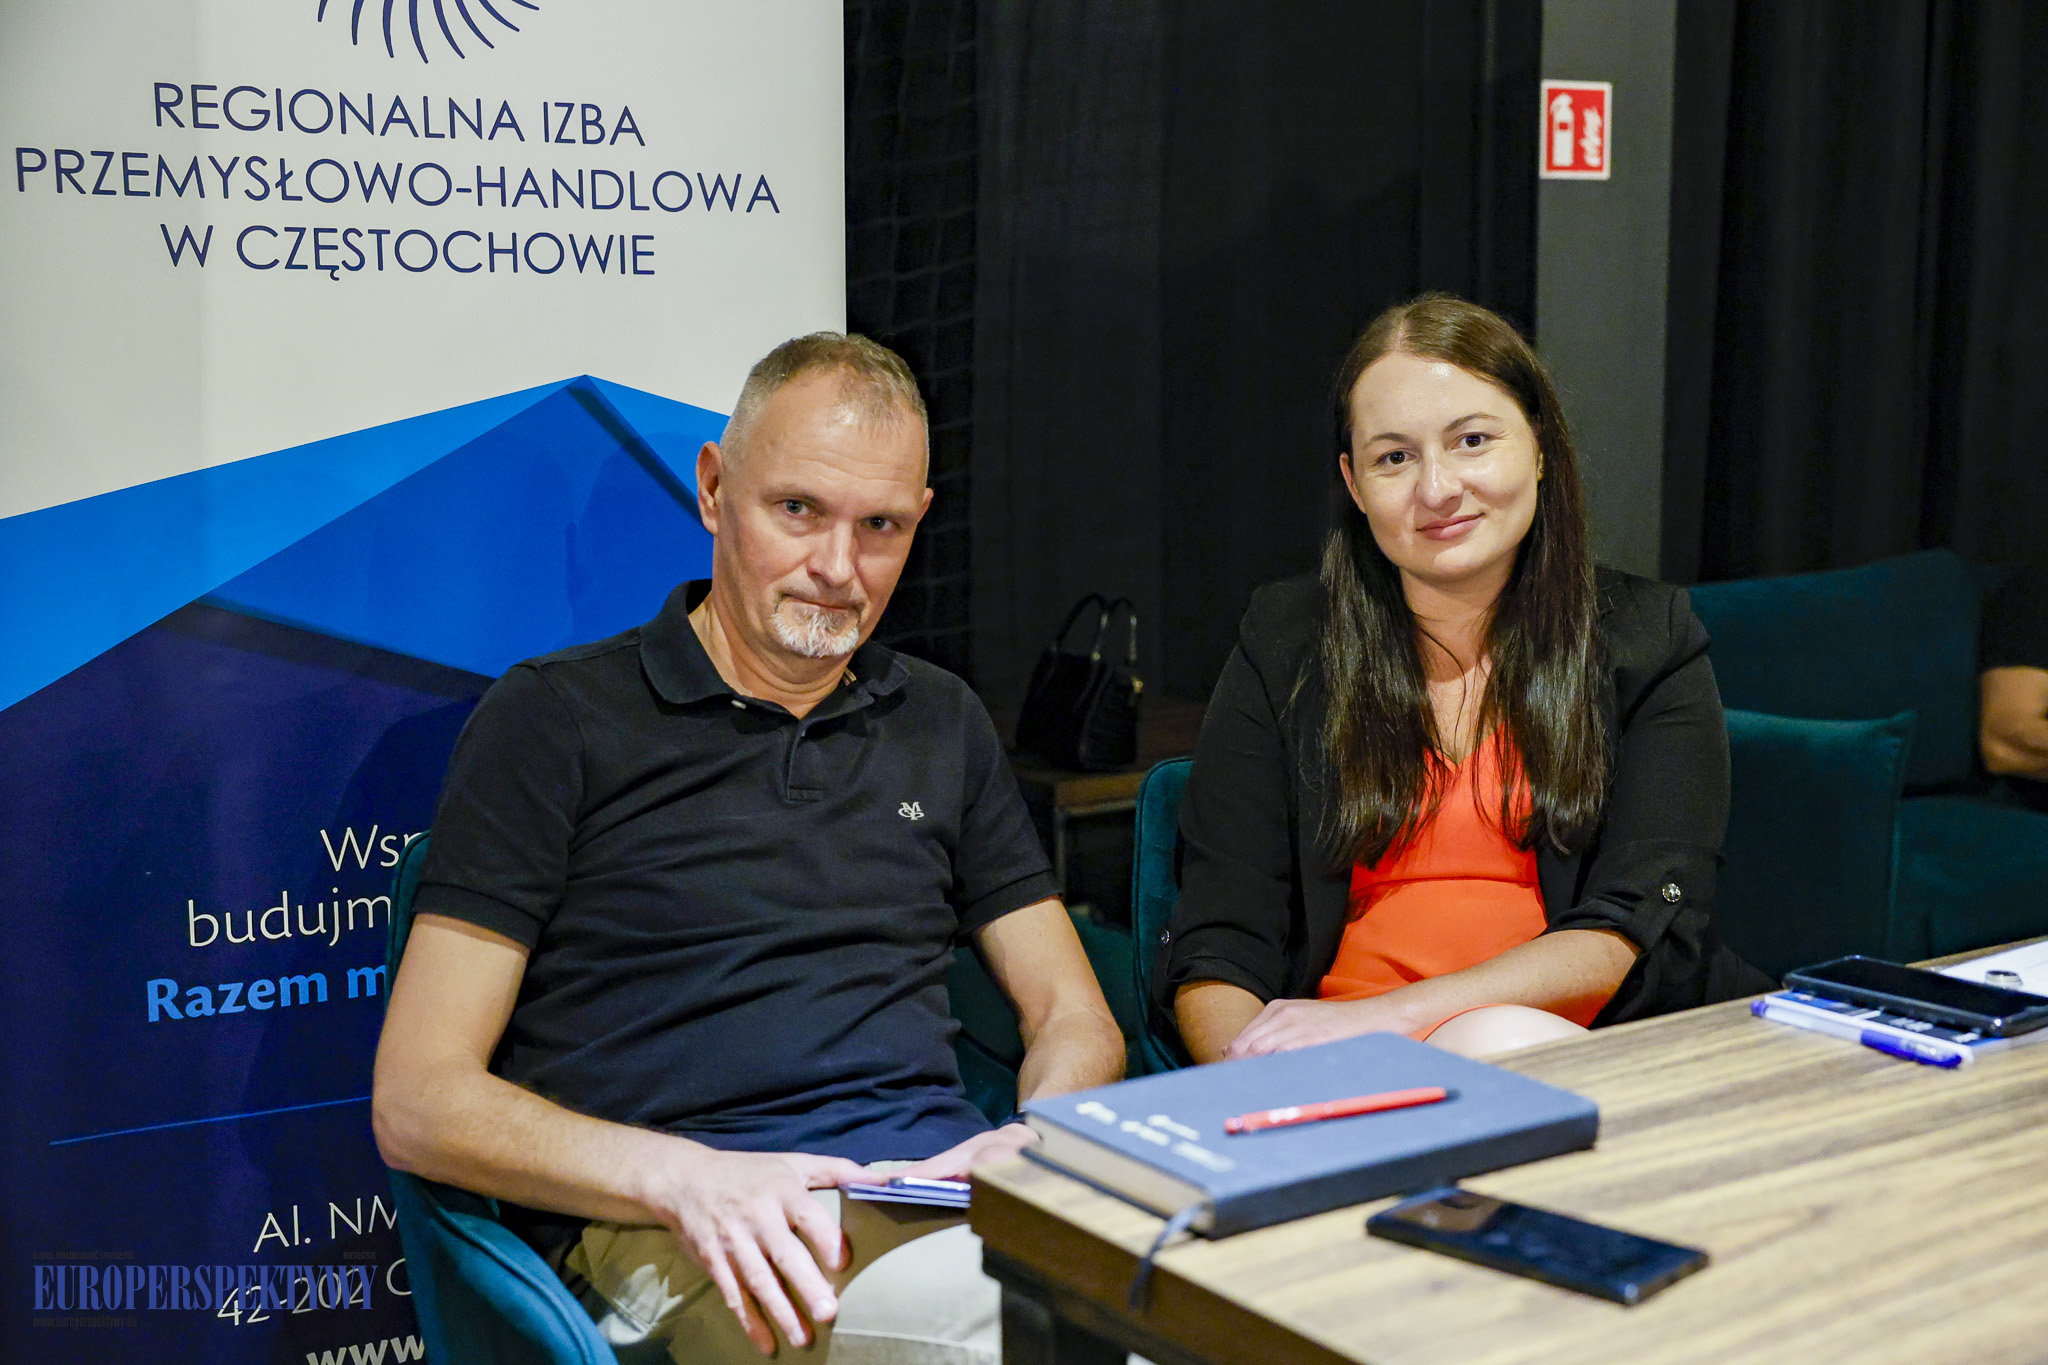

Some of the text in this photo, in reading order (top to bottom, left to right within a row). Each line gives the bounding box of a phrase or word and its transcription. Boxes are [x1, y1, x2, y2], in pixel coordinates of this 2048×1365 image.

[153, 81, 646, 147] REGIONALNA IZBA
[15, 146, 781, 214] PRZEMYSŁOWO-HANDLOWA
[159, 223, 656, 282] W CZĘSTOCHOWIE
[319, 824, 424, 872] Ws
[146, 972, 328, 1023] Razem
[253, 1204, 312, 1253] Al.
